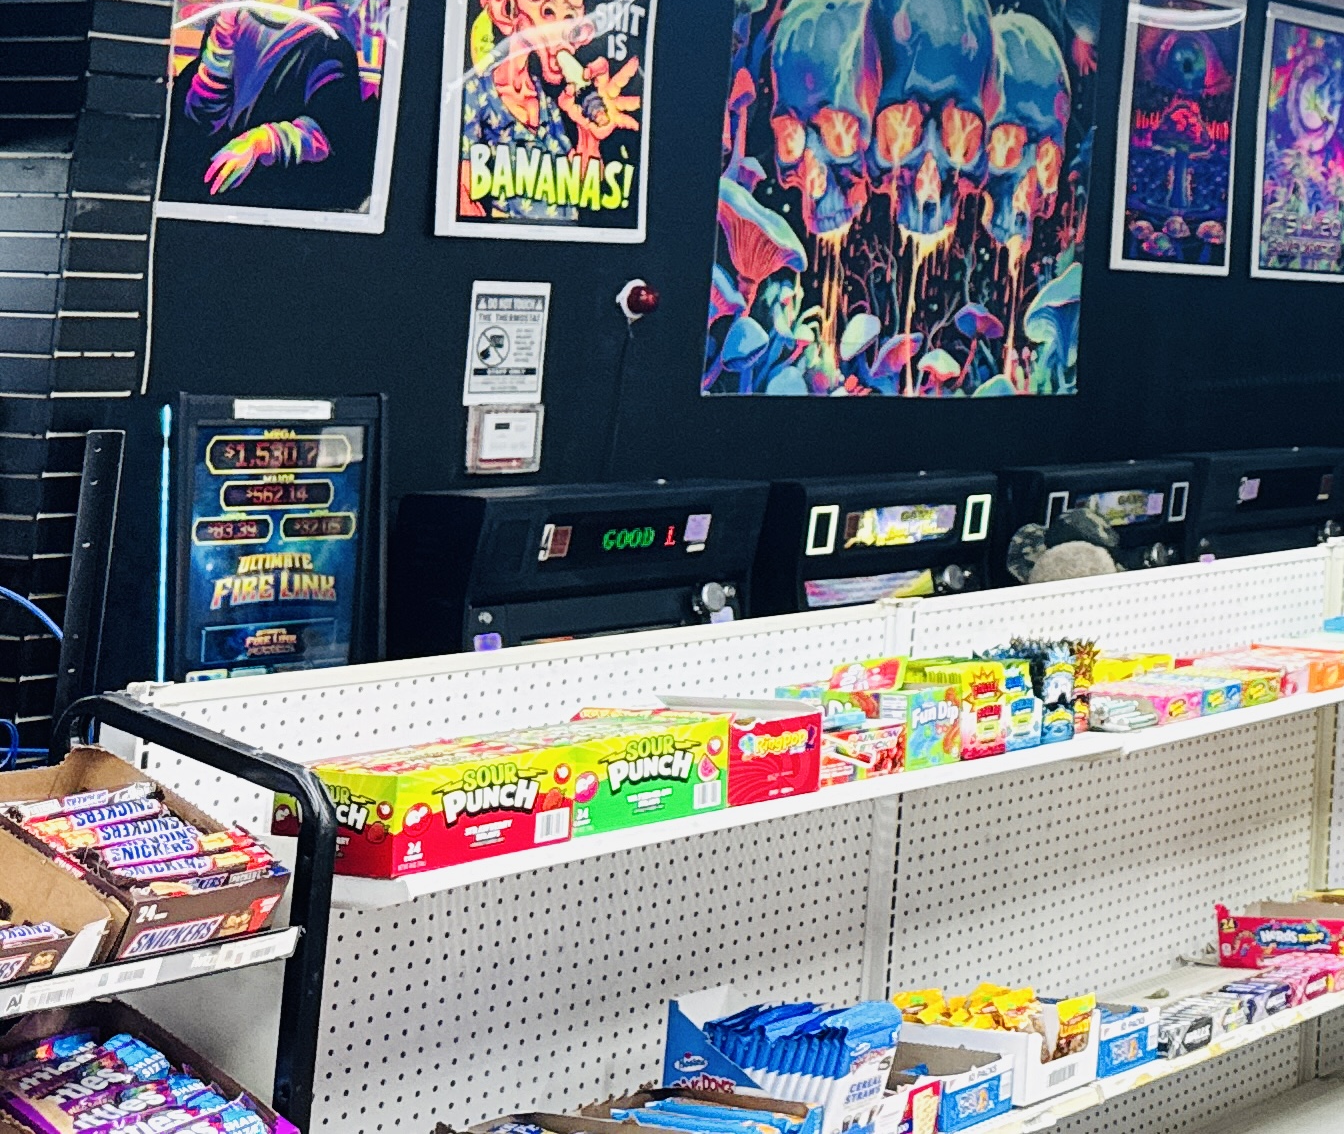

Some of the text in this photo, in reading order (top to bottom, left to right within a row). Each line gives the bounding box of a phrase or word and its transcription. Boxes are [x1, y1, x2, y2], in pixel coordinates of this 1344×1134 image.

[594, 2, 645, 37] SHIT
[607, 34, 628, 61] IS
[469, 143, 634, 211] BANANAS!
[602, 525, 676, 551] GOOD L
[237, 552, 314, 575] ULTIMATE
[210, 569, 337, 610] FIRE LINK
[912, 704, 938, 729] Fun
[938, 701, 960, 725] Dip
[625, 734, 676, 757] SOUR
[463, 763, 518, 790] SOUR
[607, 750, 694, 795] PUNCH
[443, 778, 540, 828] PUNCH
[109, 839, 195, 862] SNICKERS
[407, 841, 422, 854] 24
[137, 904, 158, 923] 24
[130, 919, 219, 955] SNICKERS
[844, 1086, 881, 1105] STRAWS
[849, 1075, 882, 1094] CEREAL
